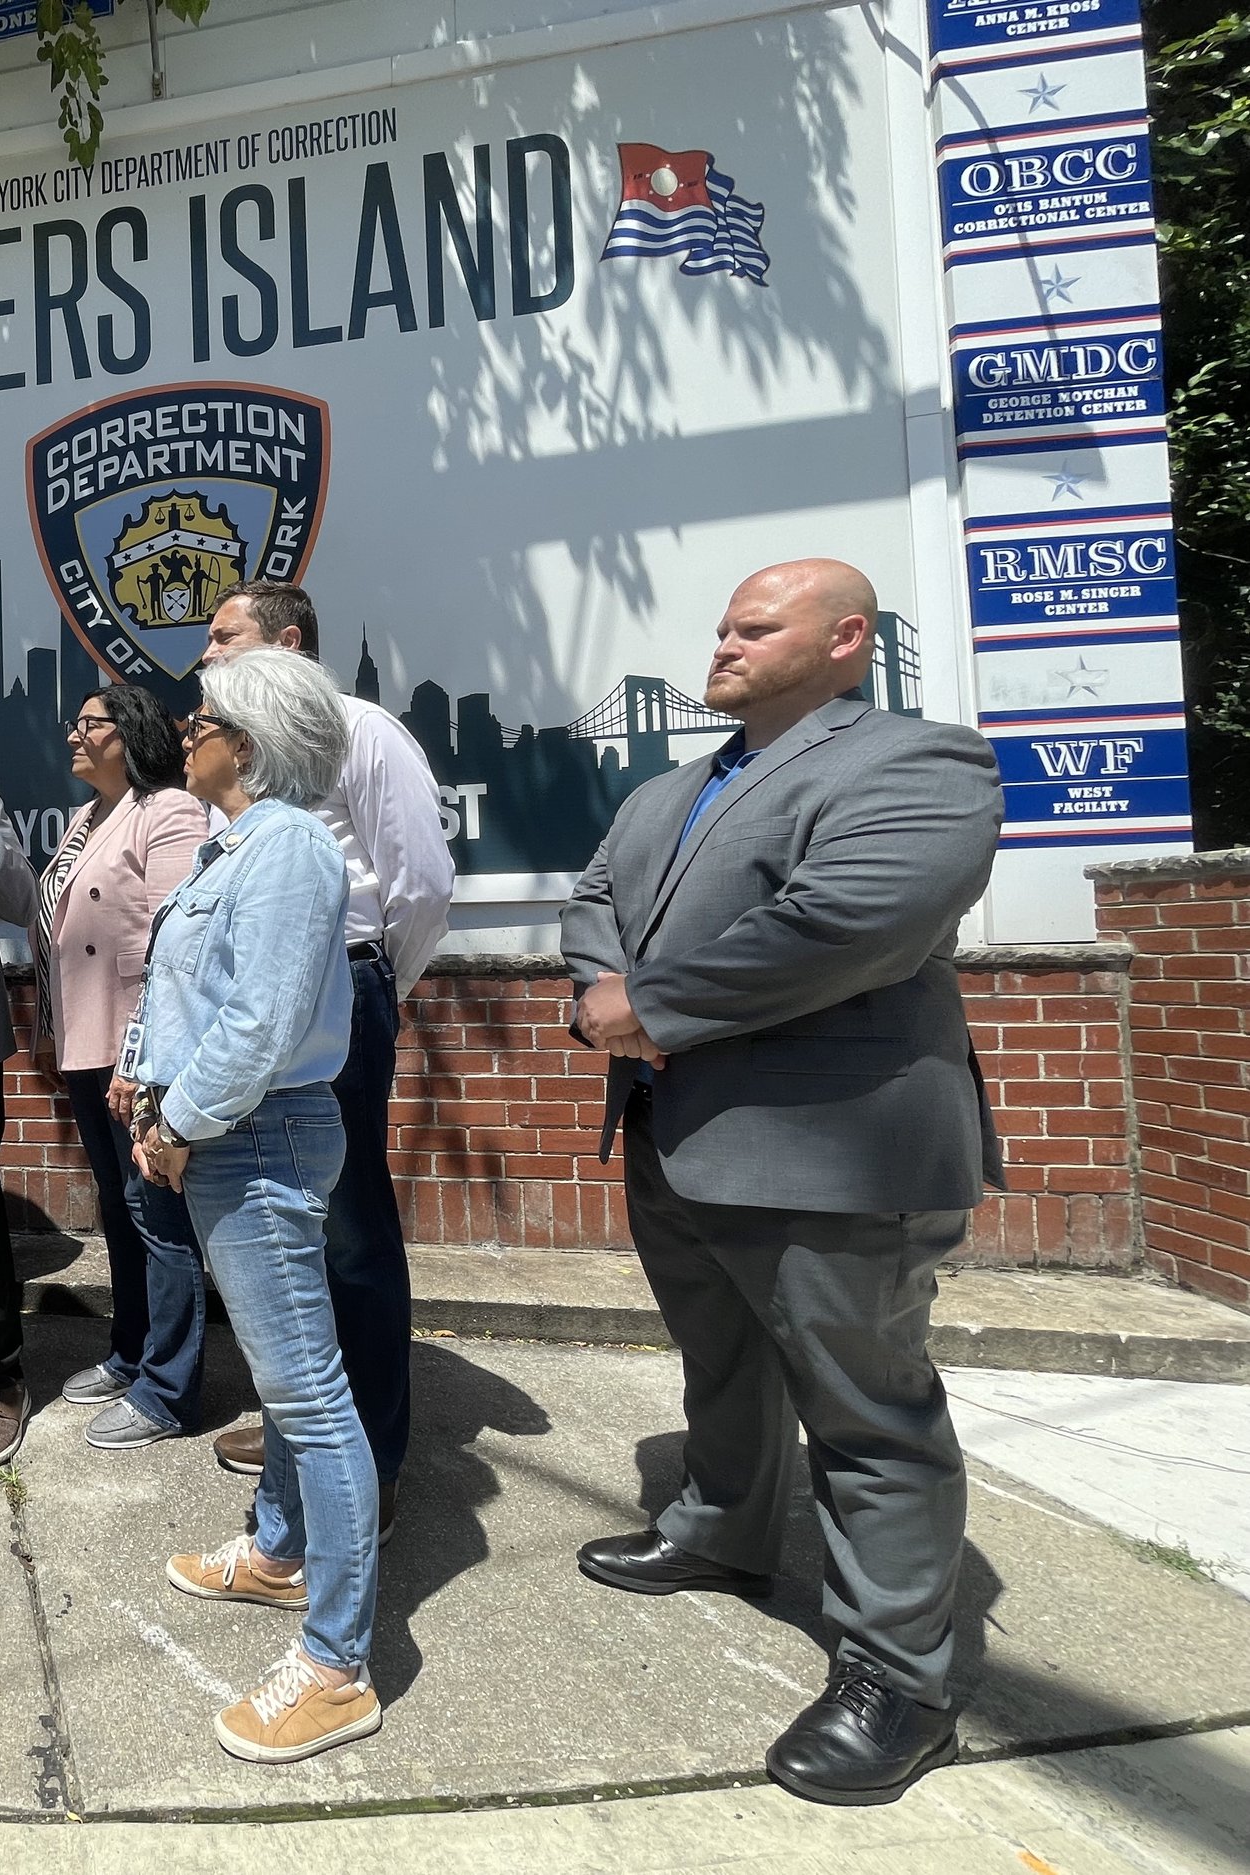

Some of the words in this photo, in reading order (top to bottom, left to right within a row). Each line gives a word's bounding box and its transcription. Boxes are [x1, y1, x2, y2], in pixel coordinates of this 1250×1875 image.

[975, 11, 1019, 26] ANNA
[1025, 8, 1043, 20] M.
[1047, 1, 1100, 16] KROSS
[1006, 17, 1070, 36] CENTER
[53, 162, 94, 206] CITY
[101, 139, 232, 194] DEPARTMENT
[237, 132, 262, 171] OF
[267, 107, 398, 165] CORRECTION
[960, 142, 1137, 198] OBCC
[953, 208, 1080, 235] CORRECTIONAL
[1085, 201, 1151, 220] CENTER
[994, 199, 1033, 216] OTIS
[1038, 191, 1108, 211] BANTUM
[188, 132, 577, 363] ISLAND
[968, 338, 1156, 390] GMDC
[982, 405, 1075, 422] DETENTION
[1080, 398, 1147, 416] CENTER
[988, 392, 1051, 410] GEORGE
[1057, 385, 1139, 404] MOTCHAN
[47, 402, 306, 478] CORRECTION
[47, 440, 306, 514] DEPARTMENT
[980, 537, 1167, 584] RMSC
[60, 559, 112, 628] CITY
[106, 637, 152, 675] OF
[262, 496, 307, 582] ORK
[1011, 590, 1054, 604] ROSE
[1060, 588, 1078, 601] M.
[1081, 585, 1142, 600] SINGER
[1044, 602, 1110, 616] CENTER
[1031, 737, 1144, 777] WF
[1053, 799, 1129, 815] FACILITY
[1067, 786, 1113, 799] WEST
[14, 806, 83, 857] YO
